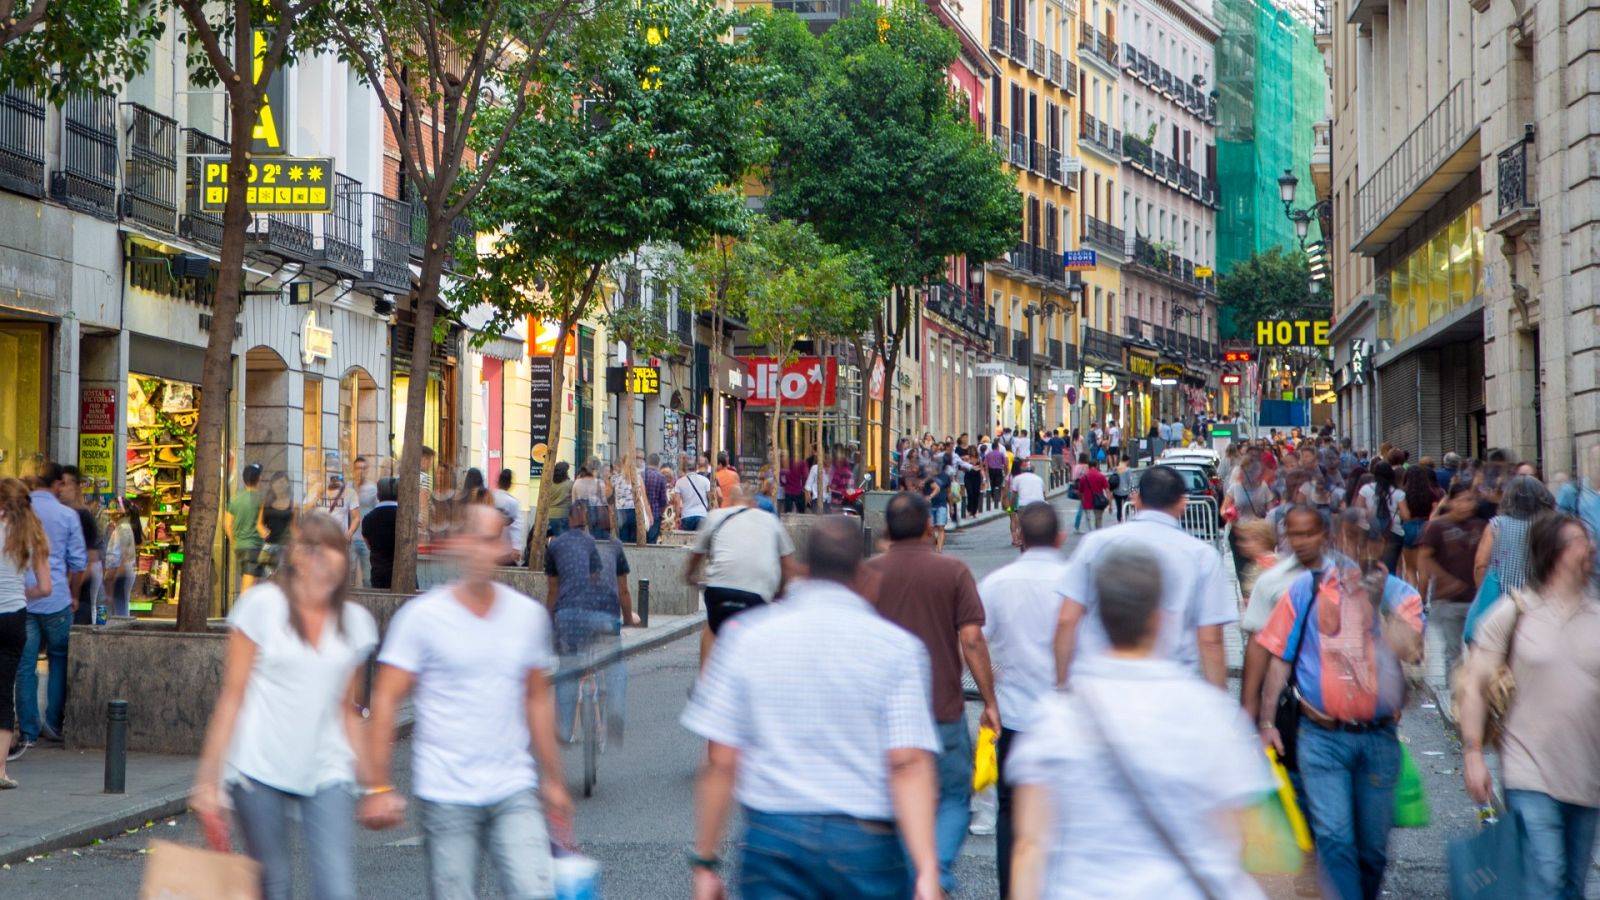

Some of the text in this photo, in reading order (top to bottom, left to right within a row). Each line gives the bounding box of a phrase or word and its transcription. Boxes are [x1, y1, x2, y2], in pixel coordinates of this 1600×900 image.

[207, 164, 258, 183] PIO
[1257, 320, 1330, 345] HOTE
[1353, 339, 1364, 385] ZARA
[82, 437, 100, 447] HOSTAL
[81, 450, 110, 459] RESIDENCIA
